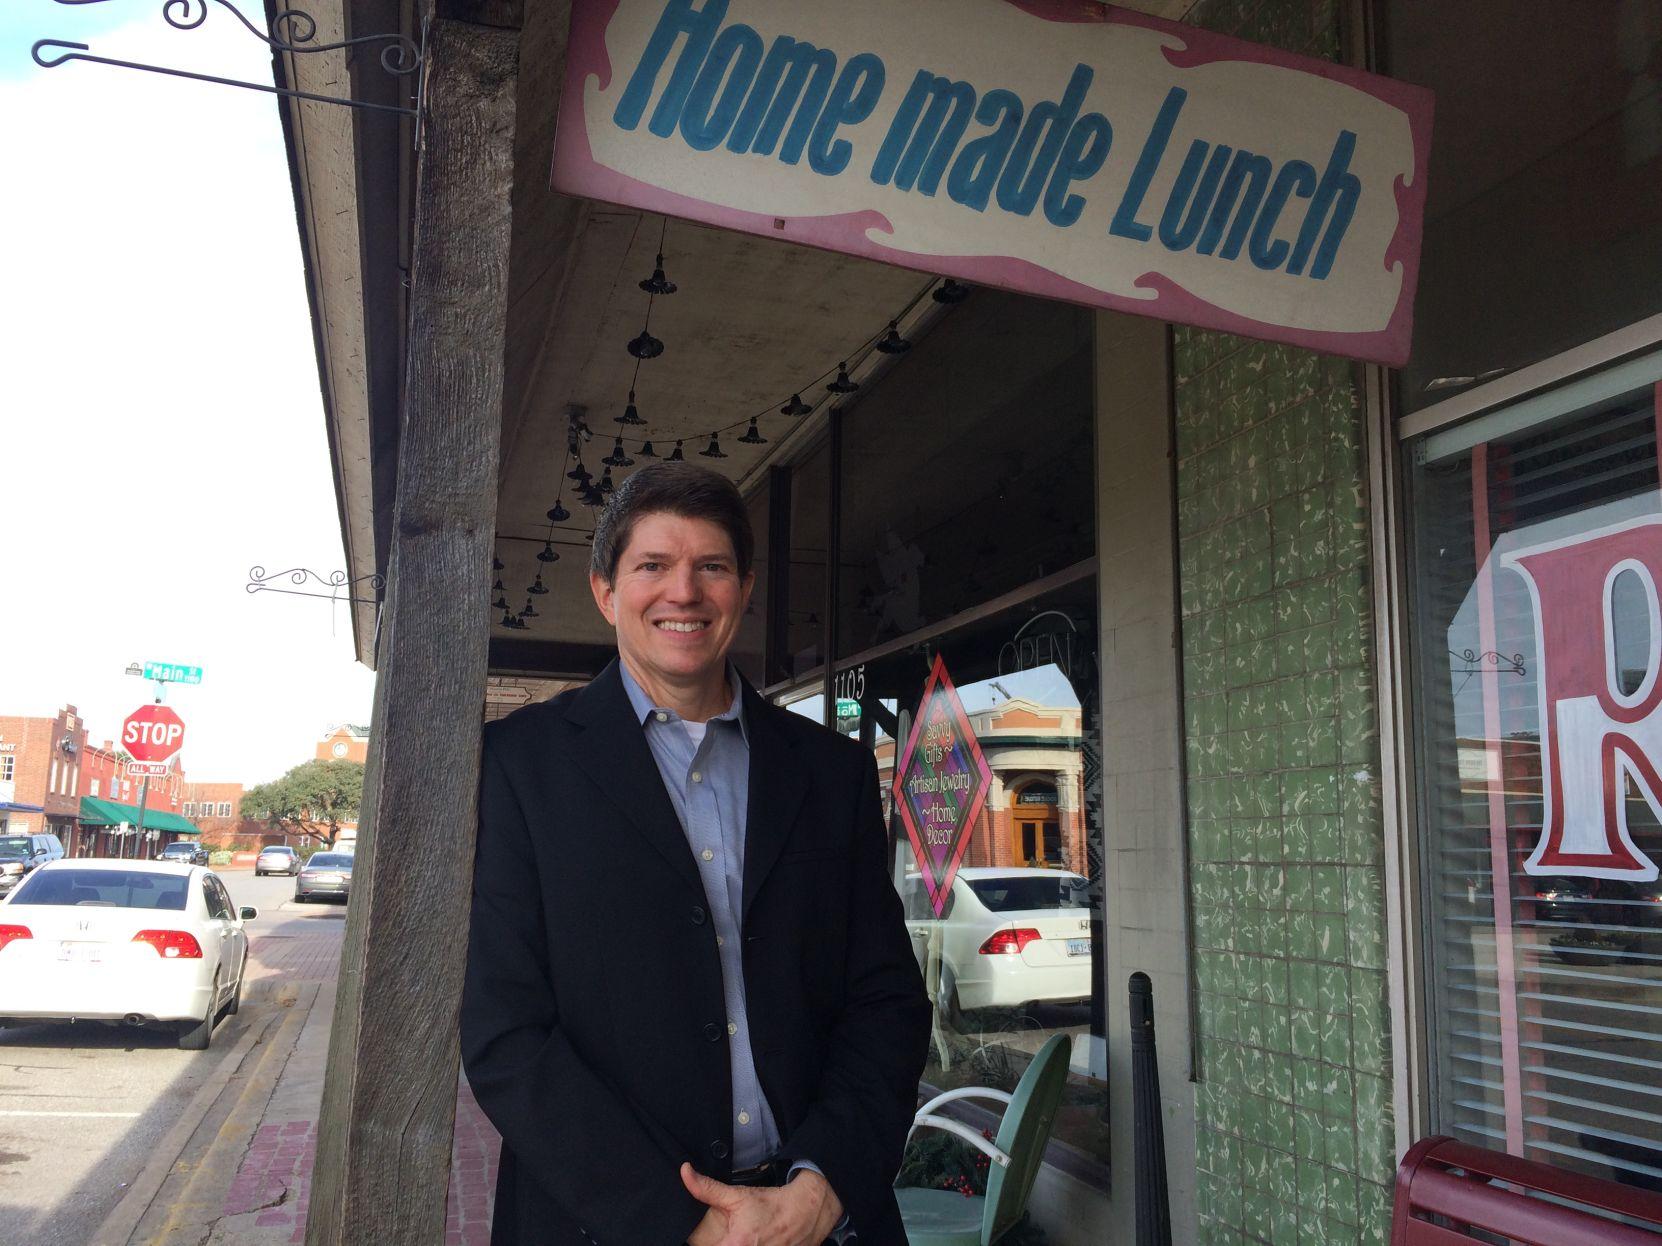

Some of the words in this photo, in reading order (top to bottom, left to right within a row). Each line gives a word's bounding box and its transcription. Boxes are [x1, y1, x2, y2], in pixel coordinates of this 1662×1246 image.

[613, 0, 886, 176] Home
[870, 62, 1113, 228] made
[1109, 86, 1361, 281] Lunch
[152, 663, 184, 682] Main
[835, 664, 865, 706] 1105
[124, 720, 183, 746] STOP
[925, 742, 943, 768] Gifts
[130, 764, 145, 773] ALL
[149, 764, 165, 774] WAY
[909, 774, 938, 797] Artisan
[939, 768, 970, 794] Jewelry
[931, 801, 957, 824] Home
